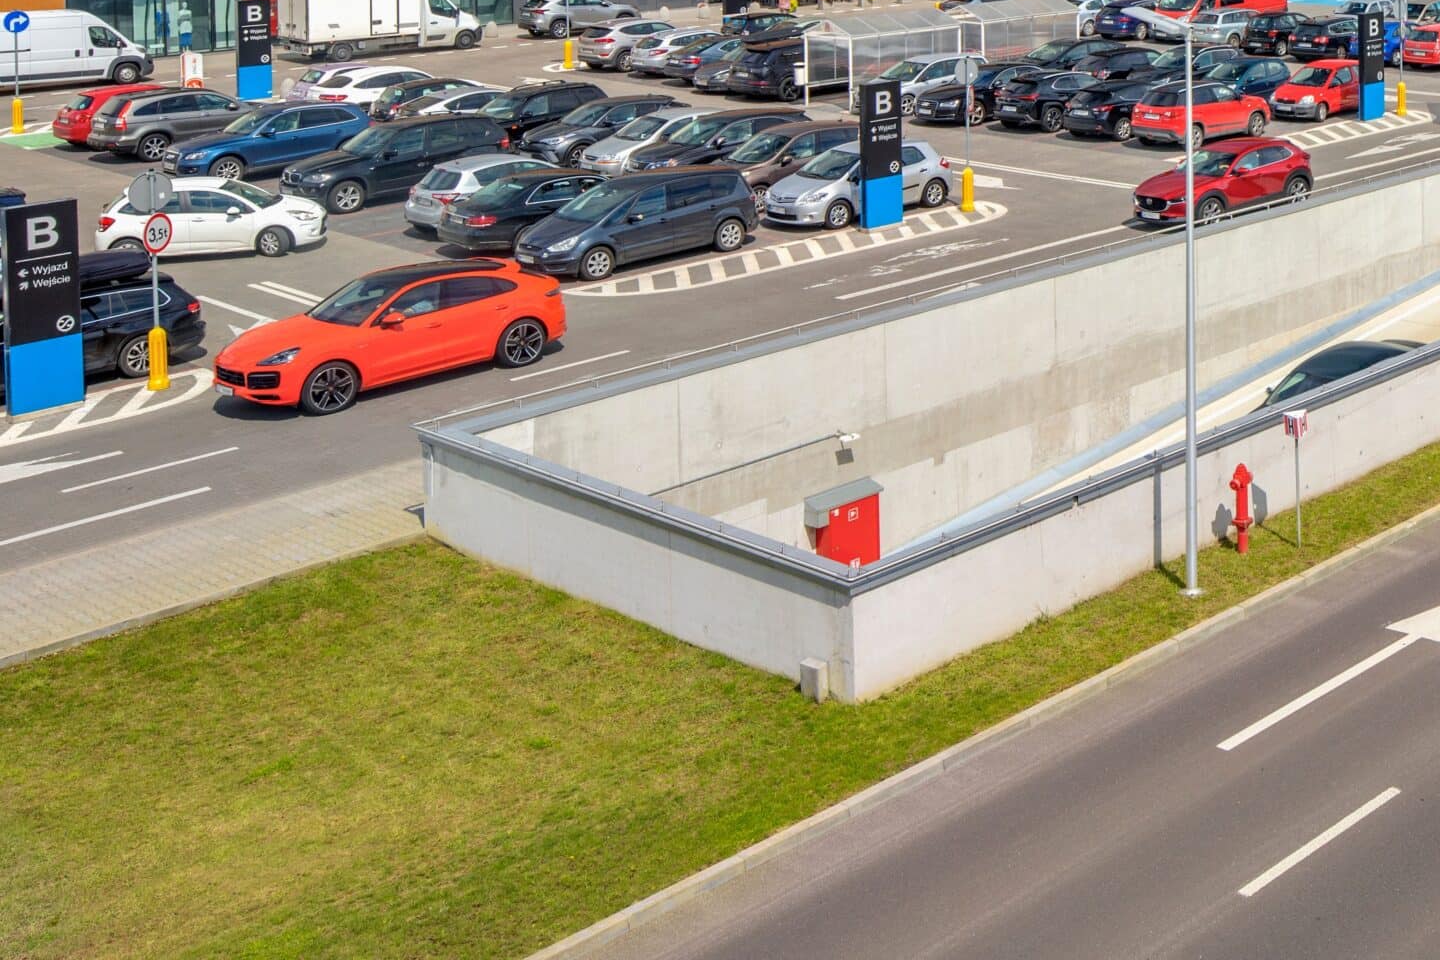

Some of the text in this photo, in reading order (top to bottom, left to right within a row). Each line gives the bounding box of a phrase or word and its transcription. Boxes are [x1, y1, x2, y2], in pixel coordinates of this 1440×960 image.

[247, 5, 262, 22] B
[1369, 19, 1379, 37] B
[875, 90, 892, 115] B
[26, 216, 59, 251] B
[32, 261, 69, 277] Wyjazd
[33, 274, 71, 289] Wejście
